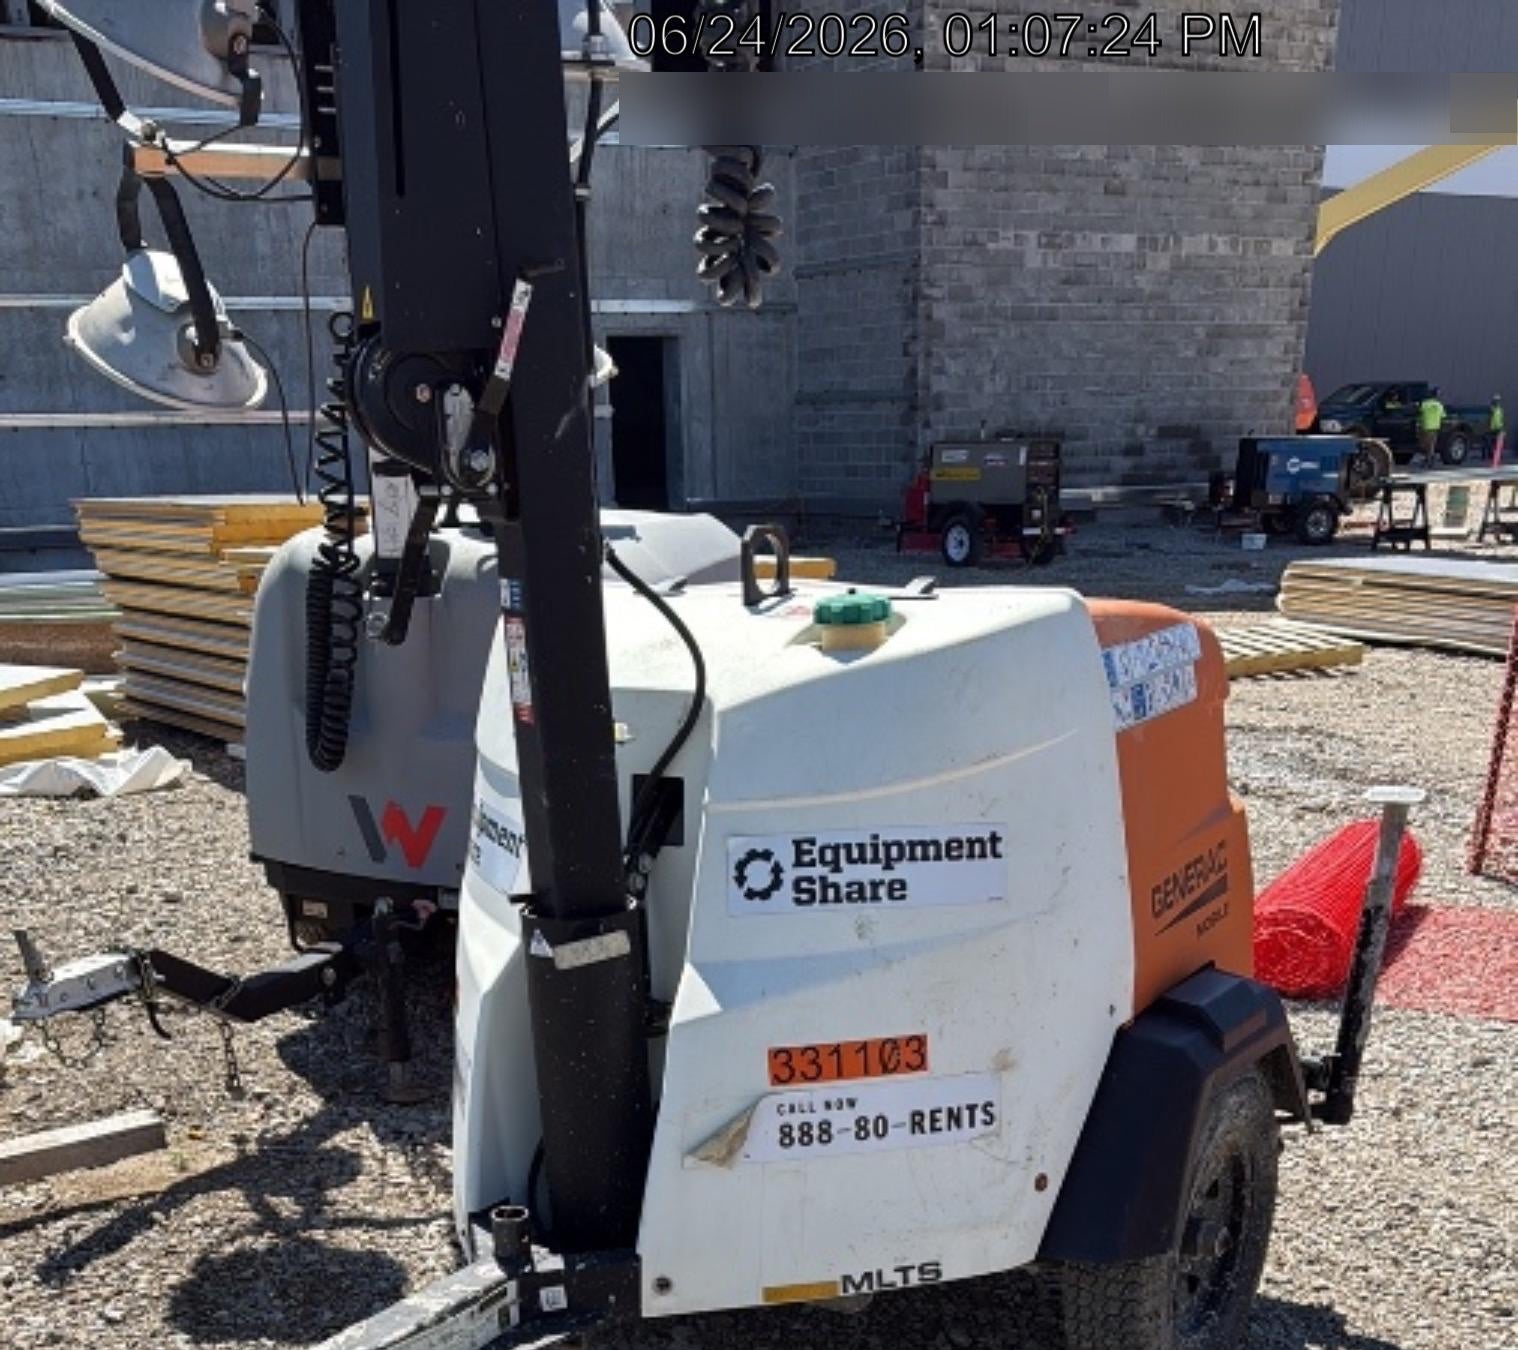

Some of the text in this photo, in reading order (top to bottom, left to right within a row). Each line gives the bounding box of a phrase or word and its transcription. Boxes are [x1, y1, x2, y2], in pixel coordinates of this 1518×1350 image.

[791, 831, 1003, 873] Equipment
[792, 875, 908, 906] Share
[1151, 839, 1228, 919] GENERAC
[772, 1033, 927, 1083] 331103
[777, 1097, 858, 1117] CALL NOW
[778, 1101, 996, 1149] 888-80-RENTS
[841, 1261, 943, 1294] MLTS
